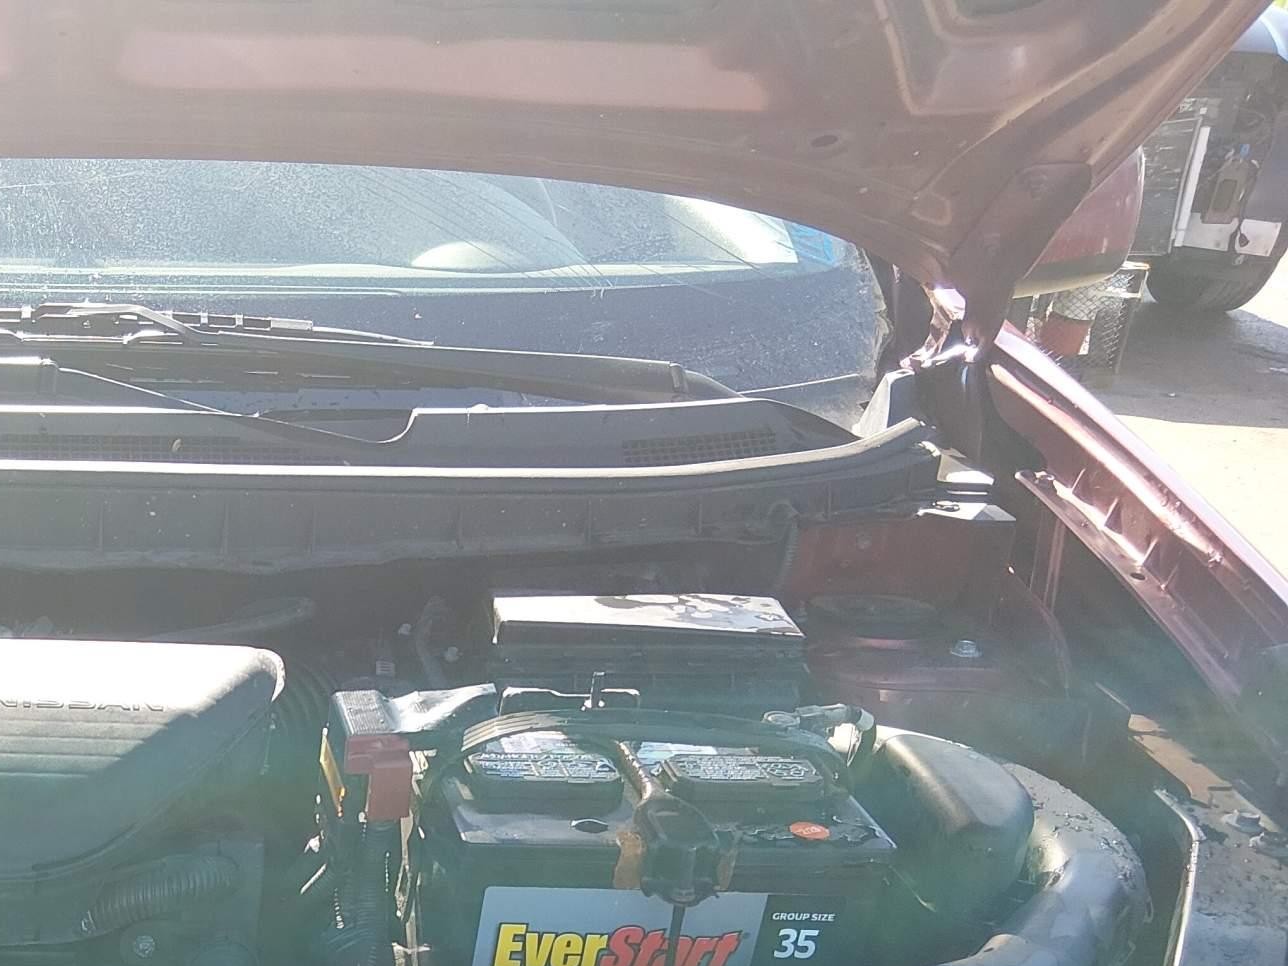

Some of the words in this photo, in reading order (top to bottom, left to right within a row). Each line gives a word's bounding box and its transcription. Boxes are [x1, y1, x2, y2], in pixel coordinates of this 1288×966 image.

[772, 912, 810, 921] GROUP
[810, 913, 835, 922] SIZE
[773, 928, 819, 959] 35
